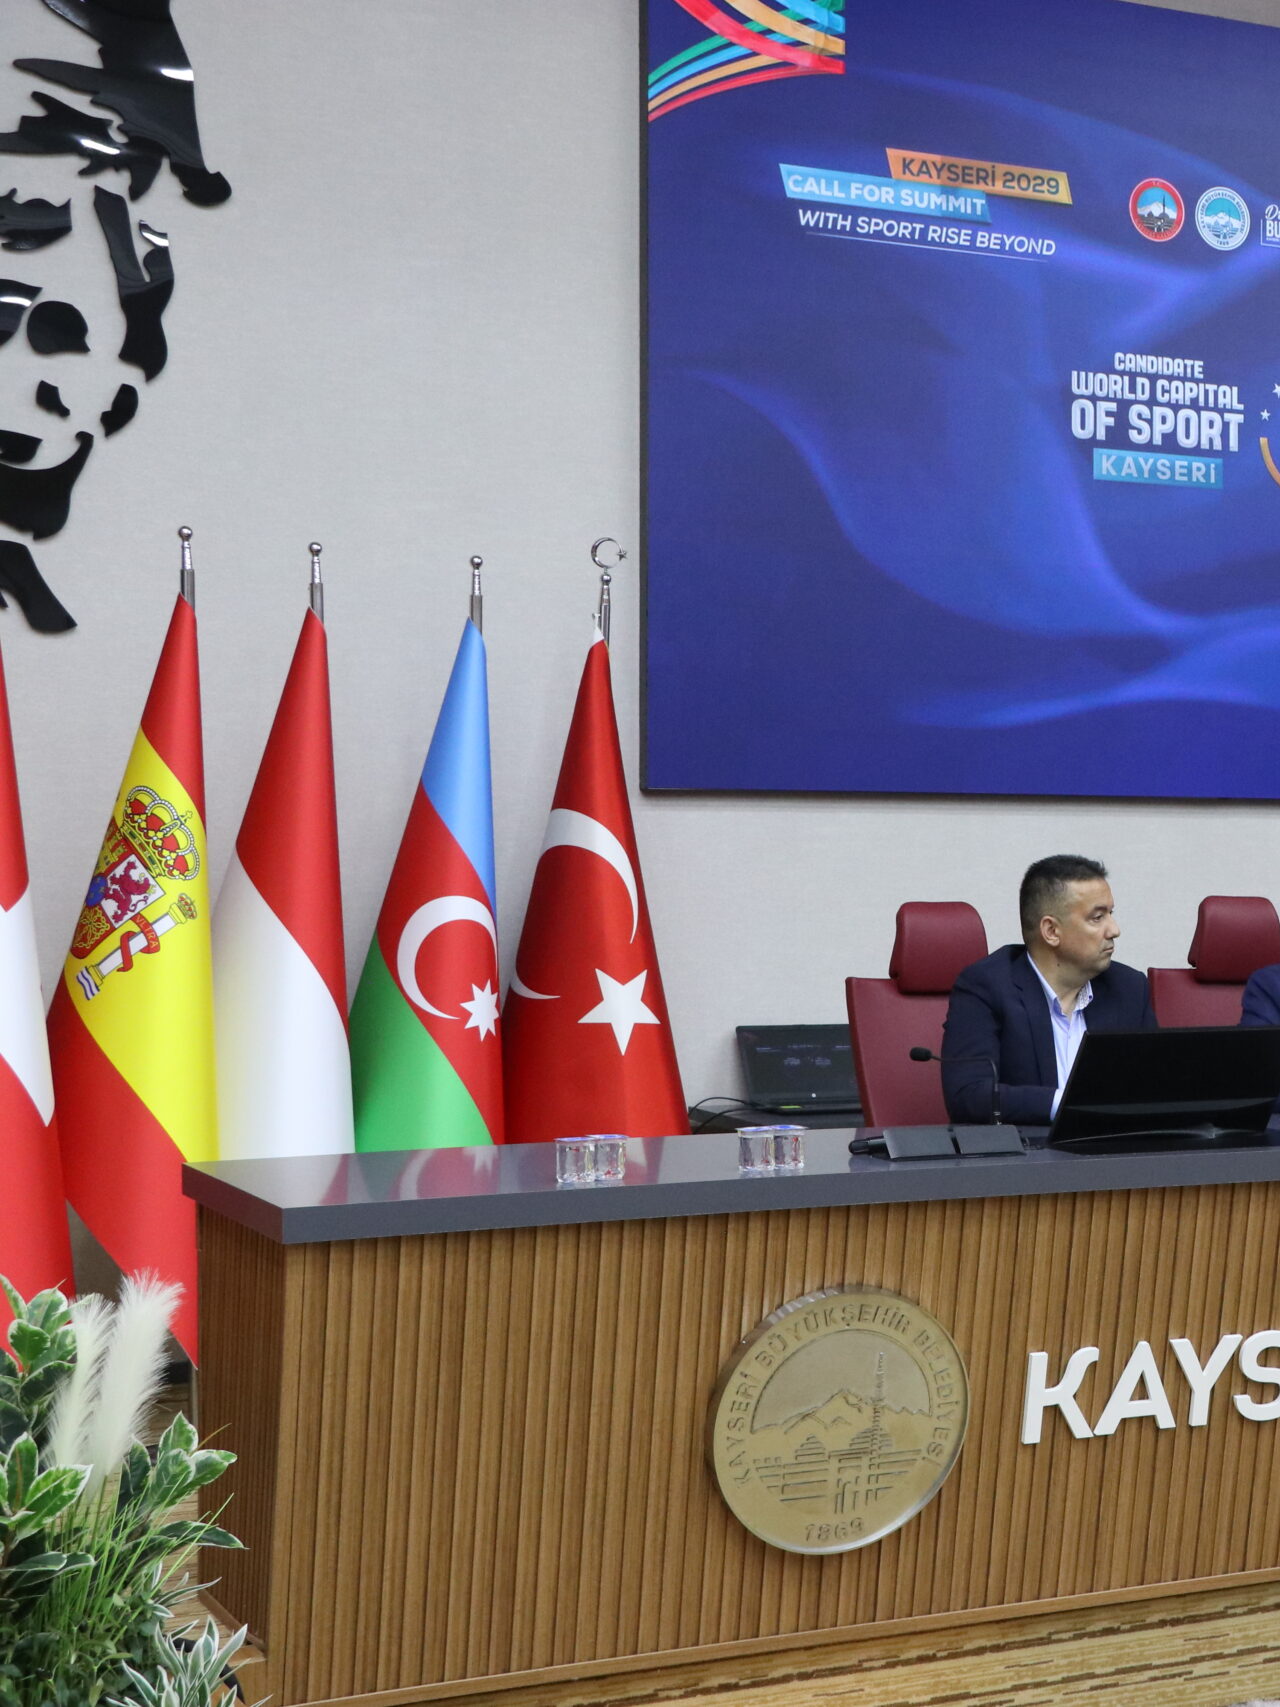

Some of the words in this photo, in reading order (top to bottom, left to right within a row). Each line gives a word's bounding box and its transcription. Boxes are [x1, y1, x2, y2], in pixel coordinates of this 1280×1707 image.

[788, 174, 845, 198] CALL
[851, 183, 895, 205] FOR
[900, 192, 986, 215] SUMMIT
[901, 157, 996, 187] KAYSERİ
[1002, 171, 1060, 195] 2029
[799, 209, 851, 231] WITH
[856, 216, 921, 239] SPORT
[927, 227, 970, 245] RISE
[976, 232, 1056, 256] BEYOND
[1114, 352, 1204, 379] CANDIDATE
[1071, 370, 1150, 401] WORLD
[1156, 379, 1244, 410] CAPITAL
[1071, 398, 1117, 441] OF
[1128, 404, 1244, 452] SPORT
